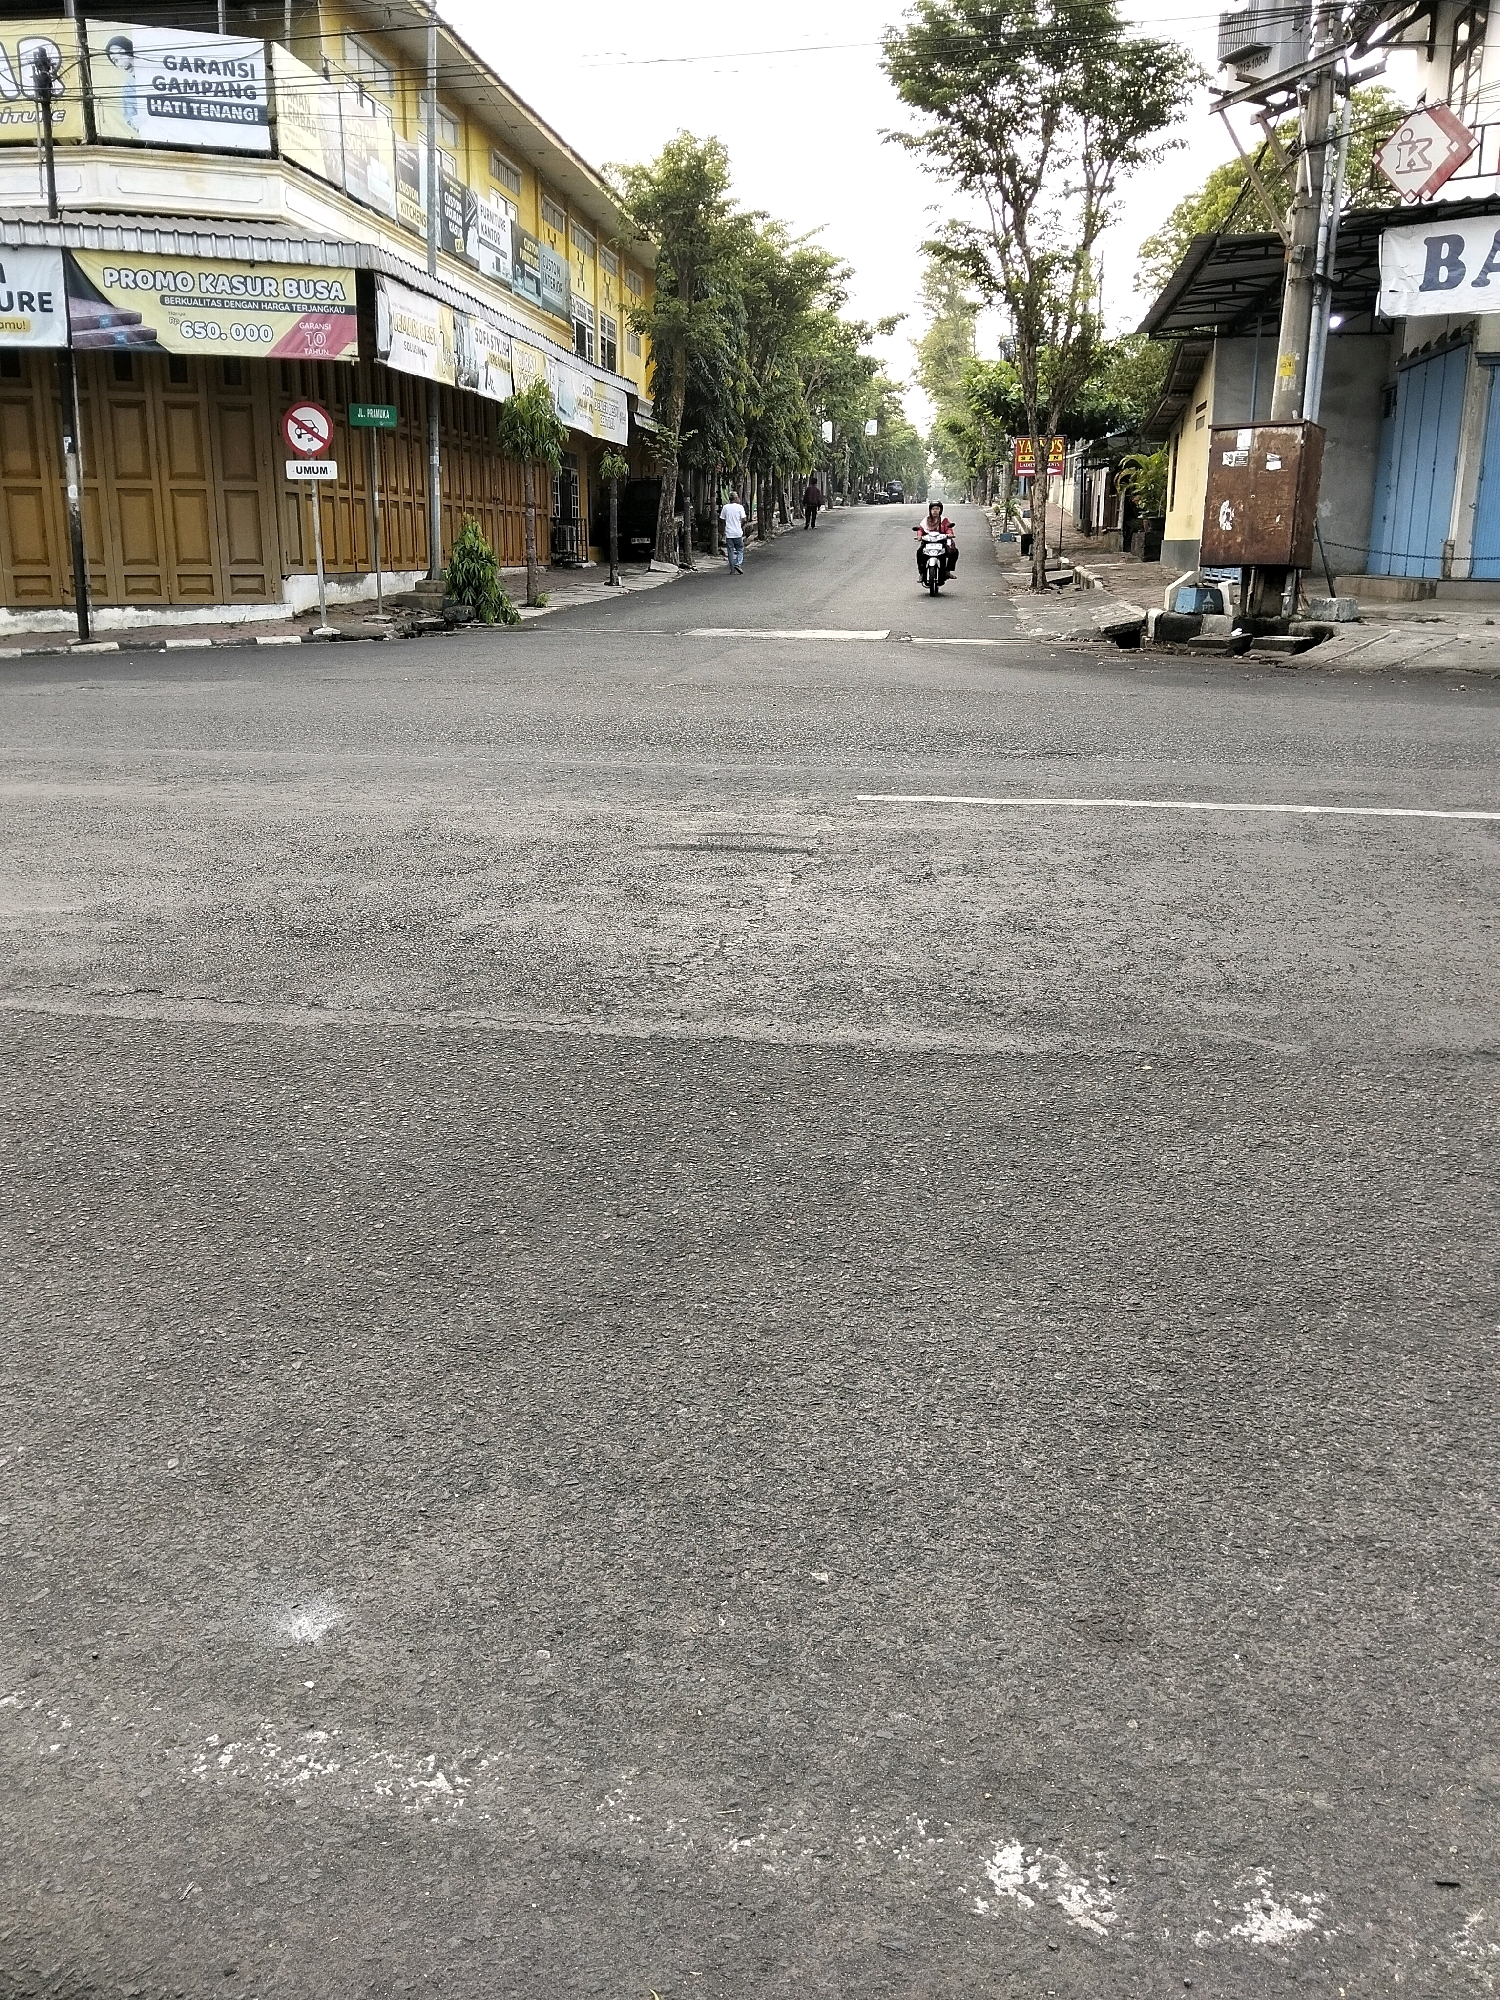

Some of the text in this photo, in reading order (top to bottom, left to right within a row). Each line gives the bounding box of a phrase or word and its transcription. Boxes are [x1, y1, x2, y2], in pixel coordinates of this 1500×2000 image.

[163, 55, 255, 79] GARANSI
[152, 75, 257, 100] GAMPANG
[150, 99, 259, 121] HATI TENANG!
[345, 131, 368, 163] SOFA
[399, 179, 419, 203] CUSTOM
[444, 191, 462, 213] CUSTOM
[400, 200, 427, 229] KITCHENS
[480, 204, 507, 233] FURNITURE
[480, 221, 501, 246] KANTOR
[542, 254, 561, 279] CUSTOM
[103, 267, 346, 301] PROMO KASUR BUSA
[543, 270, 563, 294] INTERIOR
[164, 296, 346, 313] BERKUALITAS DENGAN HARGA TERJANGKAU
[299, 322, 331, 331] GARANSI
[305, 331, 326, 347] 10
[304, 348, 329, 356] TAHUN
[358, 408, 390, 419] JL. PRAMUKA
[295, 466, 328, 475] UMUM
